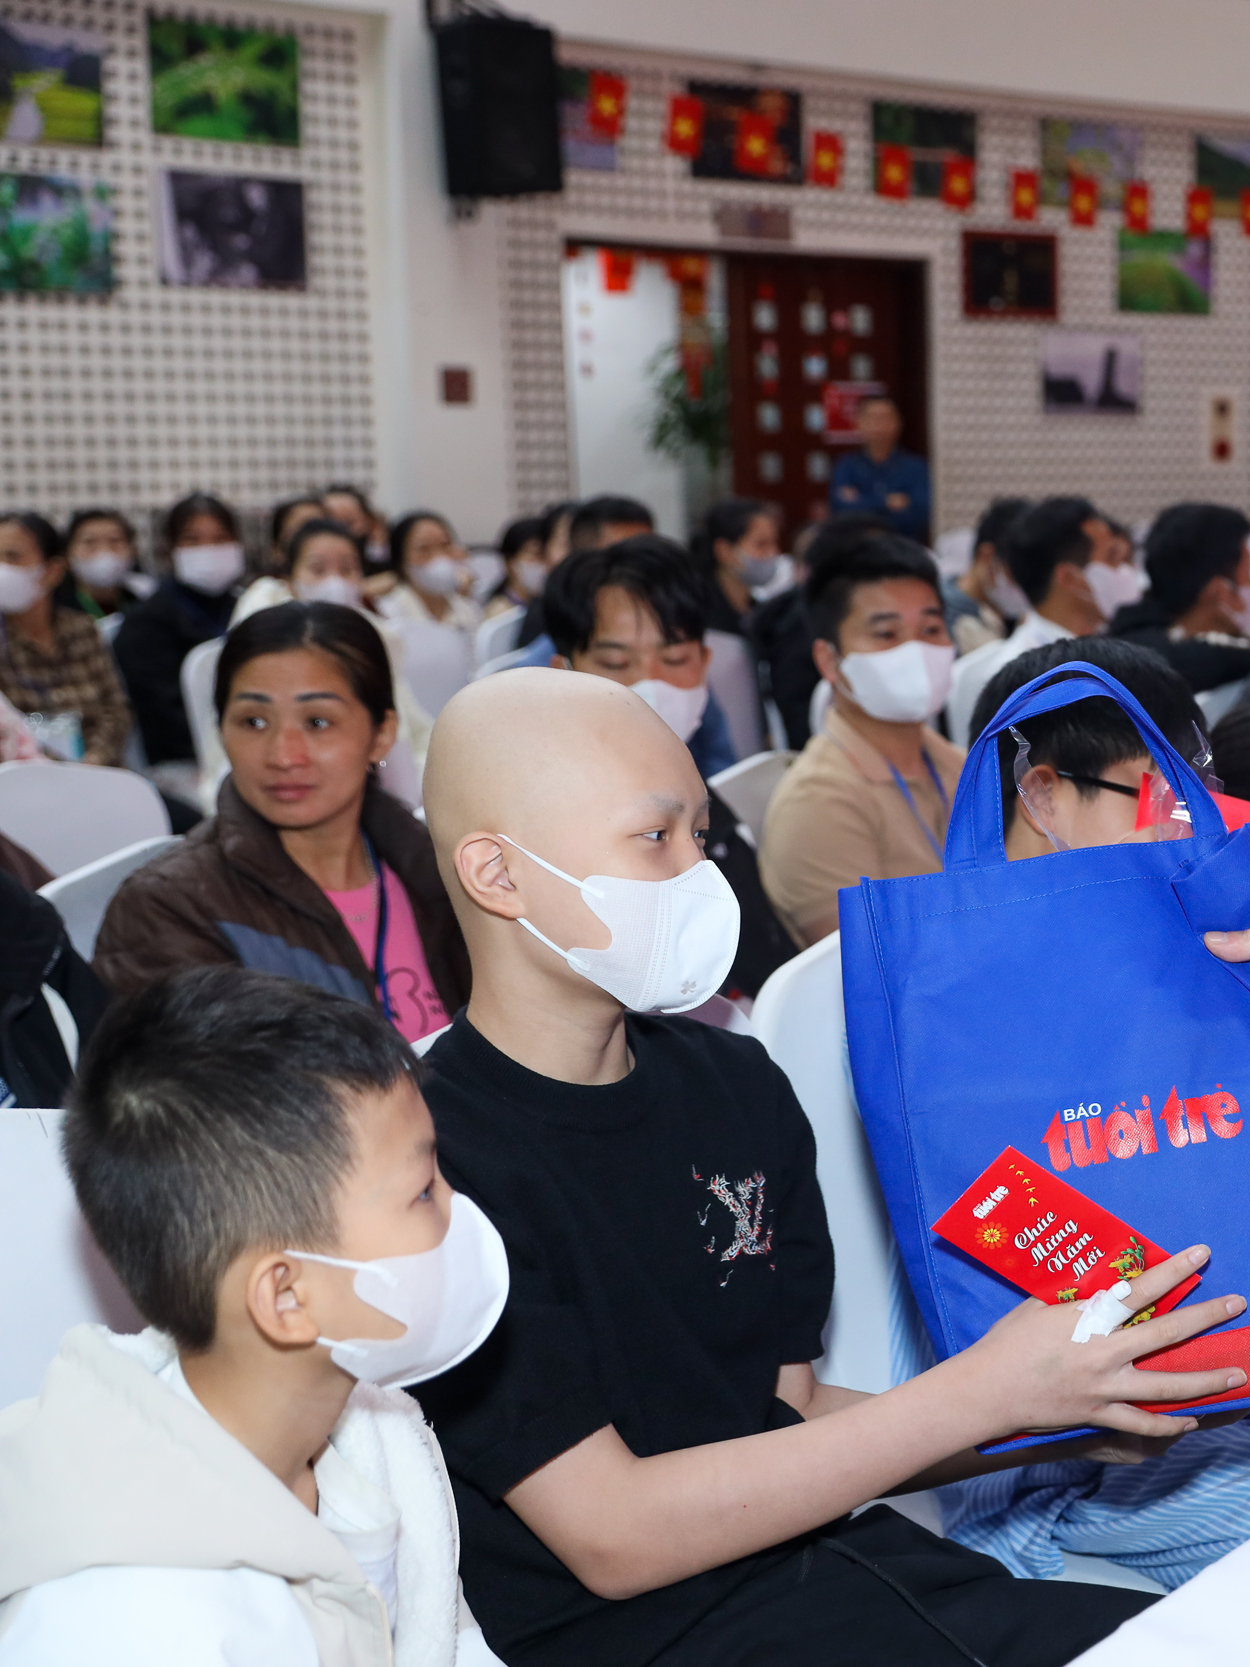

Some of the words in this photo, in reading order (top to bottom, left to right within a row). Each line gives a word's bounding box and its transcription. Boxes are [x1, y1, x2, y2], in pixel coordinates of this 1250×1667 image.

[1041, 1094, 1159, 1172] tuổi
[1158, 1083, 1244, 1149] trẻ
[1063, 1103, 1102, 1122] BÁO
[1014, 1211, 1057, 1250] Chúc
[1030, 1219, 1079, 1267] Mừng
[1046, 1232, 1094, 1273] Năm
[1071, 1246, 1106, 1282] Mới
